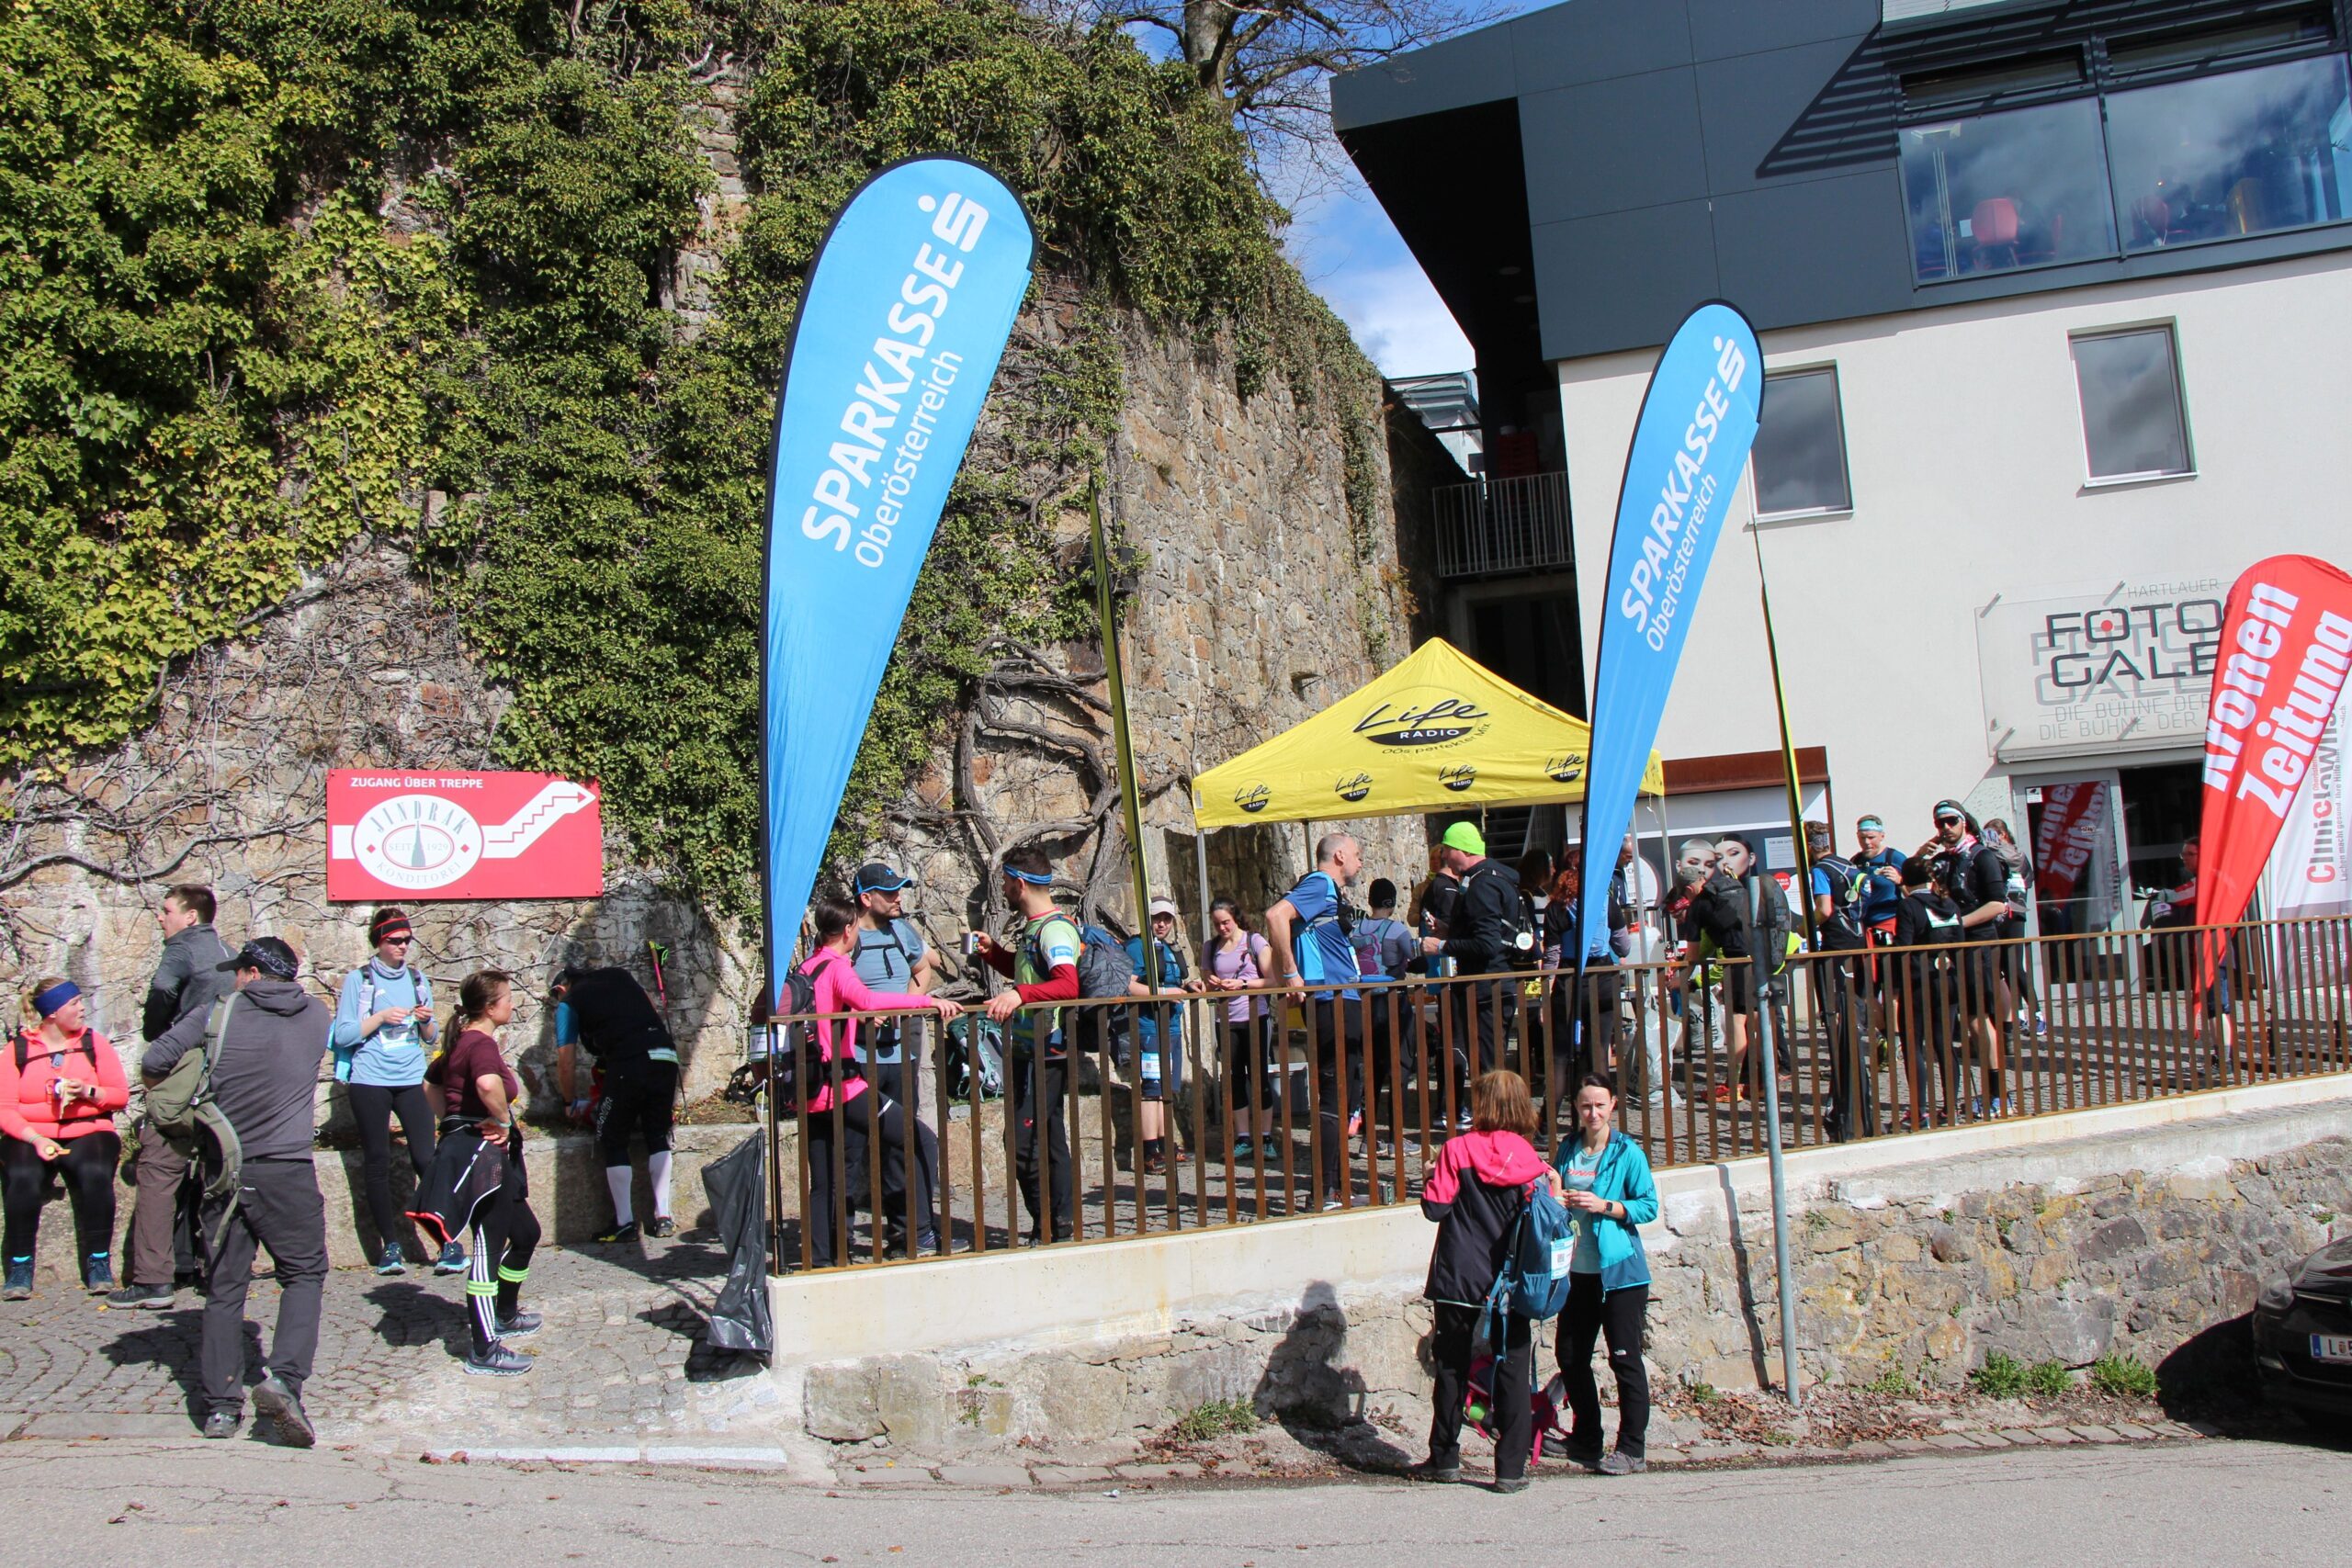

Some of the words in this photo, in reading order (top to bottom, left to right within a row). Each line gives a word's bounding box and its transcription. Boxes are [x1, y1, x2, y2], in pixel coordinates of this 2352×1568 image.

[801, 242, 964, 551] SPARKASSE
[854, 351, 963, 568] Oberösterreich
[1621, 378, 1728, 633] SPARKASSE
[1645, 474, 1717, 652] Oberösterreich
[2127, 578, 2219, 599] HARTLAUER
[2046, 599, 2222, 647] FOTO
[2051, 640, 2220, 687] GALE
[1352, 699, 1488, 732] Life
[2055, 705, 2084, 722] DIE
[1399, 729, 1460, 739] RADIO
[1415, 737, 1476, 755] perfekter
[1474, 722, 1491, 737] Mix
[1439, 764, 1477, 781] Life
[1544, 753, 1584, 773] Life
[351, 777, 401, 787] ZUGANG
[404, 776, 436, 787] ÜBER
[439, 778, 483, 788] TREPPE
[1335, 773, 1374, 793] Life
[1560, 770, 1578, 778] RADIO
[1235, 784, 1272, 803] Life
[1349, 789, 1367, 797] RADIO
[1249, 800, 1266, 808] RADIO
[370, 800, 469, 835] JINDRAK
[377, 862, 461, 884] KONDITOREI
